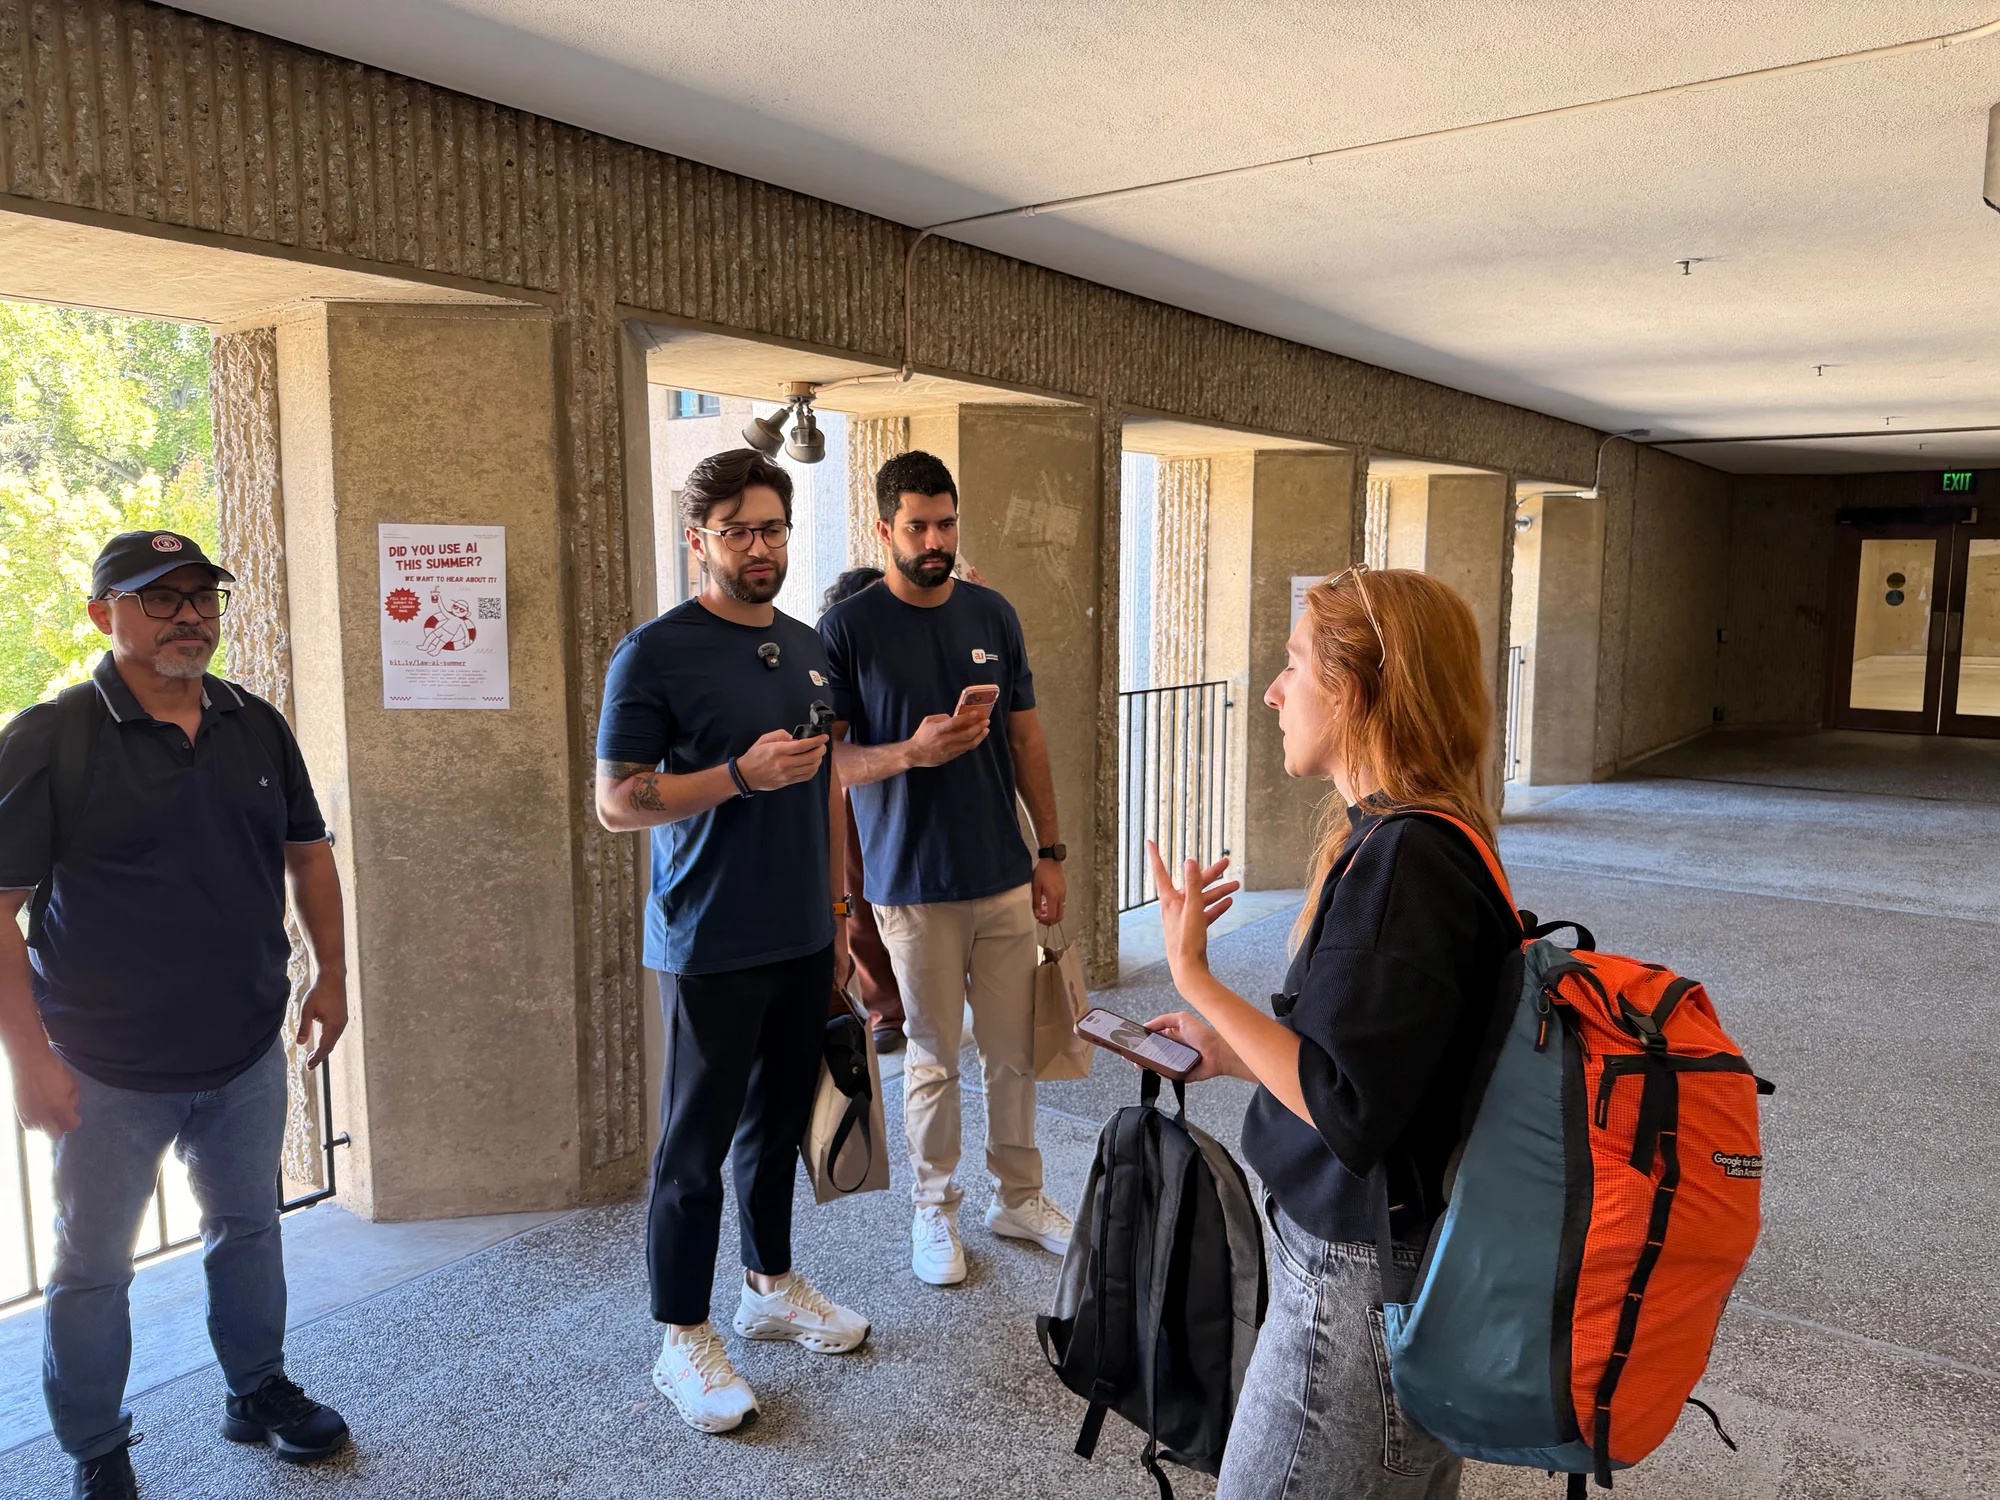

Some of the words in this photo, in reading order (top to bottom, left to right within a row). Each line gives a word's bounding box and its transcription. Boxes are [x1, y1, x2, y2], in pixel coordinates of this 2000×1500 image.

[1943, 472, 1972, 491] EXIT
[389, 546, 407, 557] DID
[411, 545, 435, 556] YOU
[439, 543, 461, 554] USE
[465, 542, 478, 553] AI
[395, 559, 422, 571] THIS
[426, 556, 482, 569] SUMMER?
[1714, 1153, 1741, 1167] Google
[1743, 1157, 1751, 1166] for
[1727, 1166, 1743, 1175] Latin
